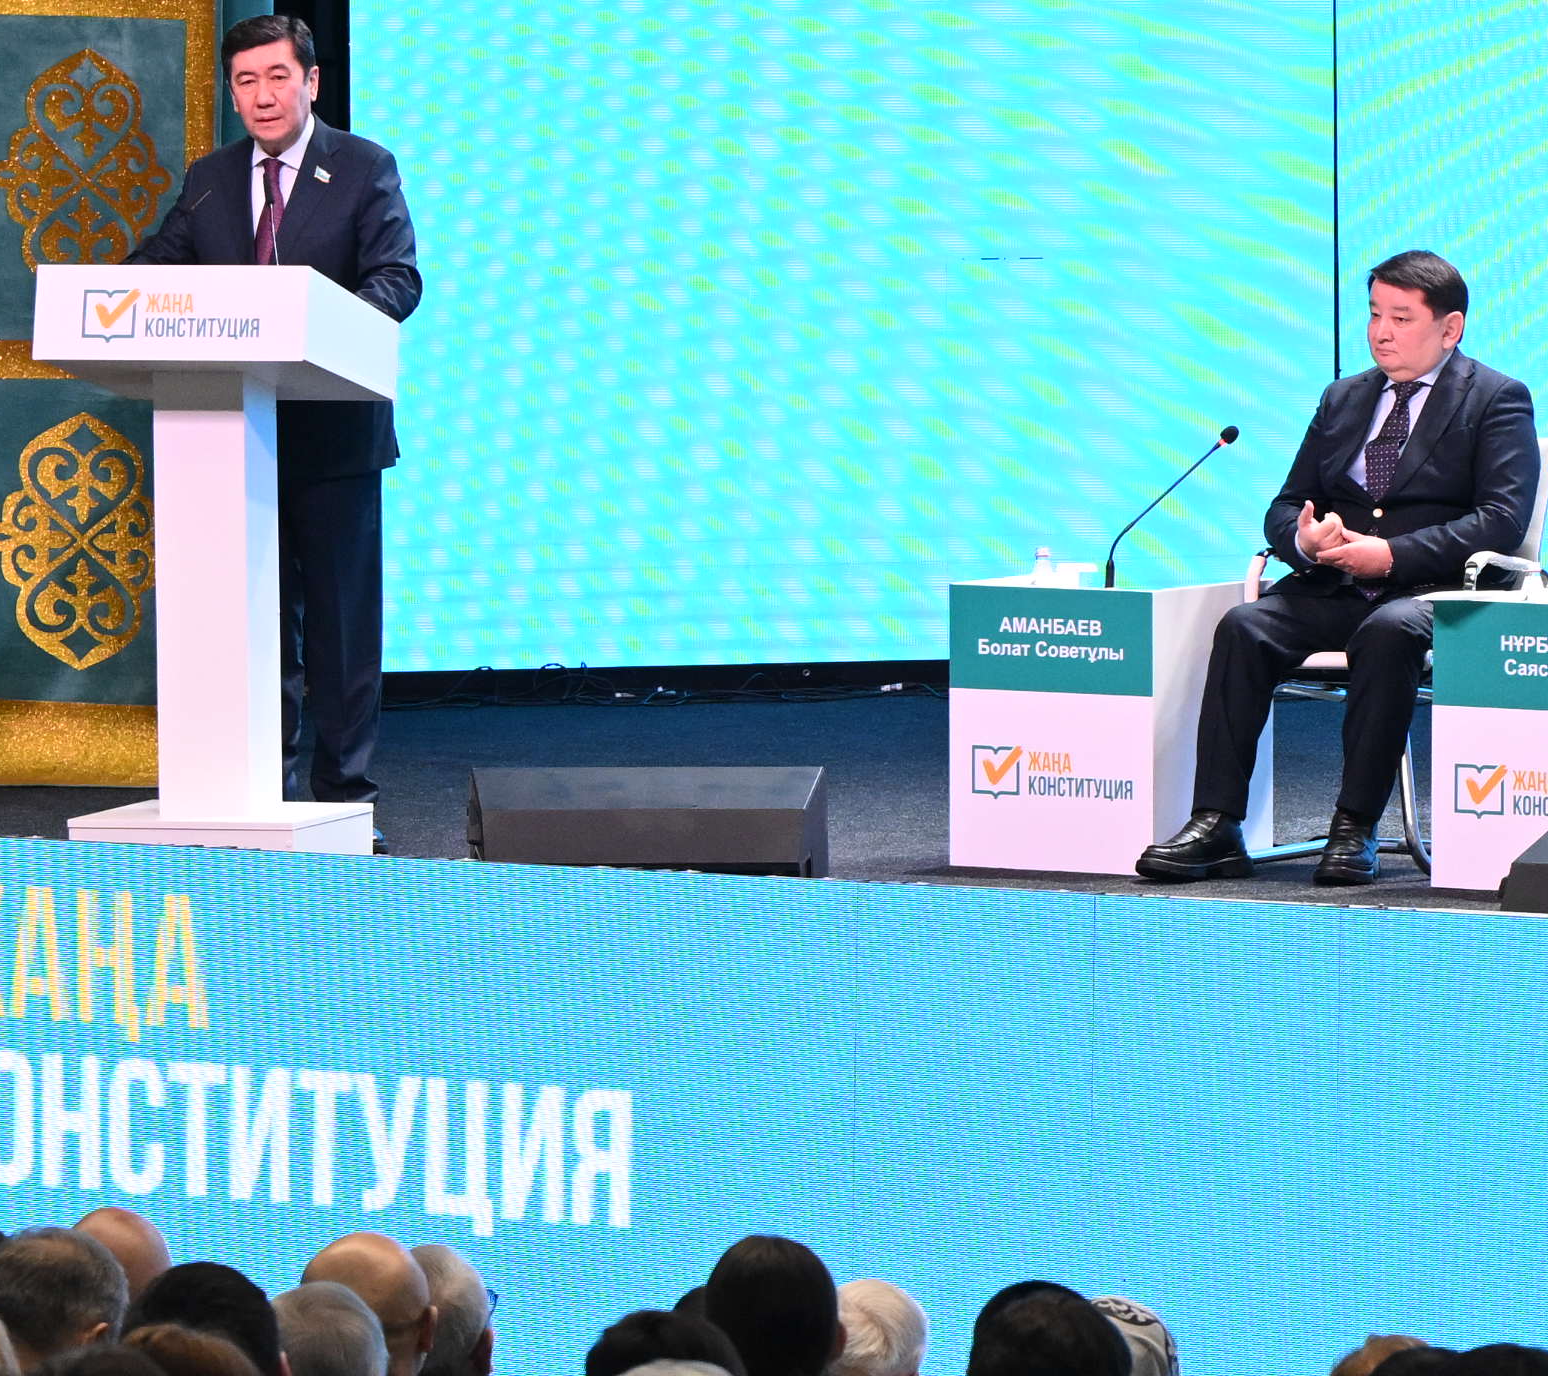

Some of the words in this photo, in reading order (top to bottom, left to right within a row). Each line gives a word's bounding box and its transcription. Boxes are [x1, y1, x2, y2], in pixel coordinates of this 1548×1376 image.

[145, 293, 194, 315] ЖАҢА
[144, 317, 260, 339] КОНСТИТУЦИЯ
[999, 617, 1102, 636] АМАНБАЕВ
[977, 638, 1030, 656] Болат
[1035, 641, 1124, 663] Советұлы
[1028, 751, 1072, 774] ЖАҢА
[1028, 775, 1133, 801] КОНСТИТУЦИЯ
